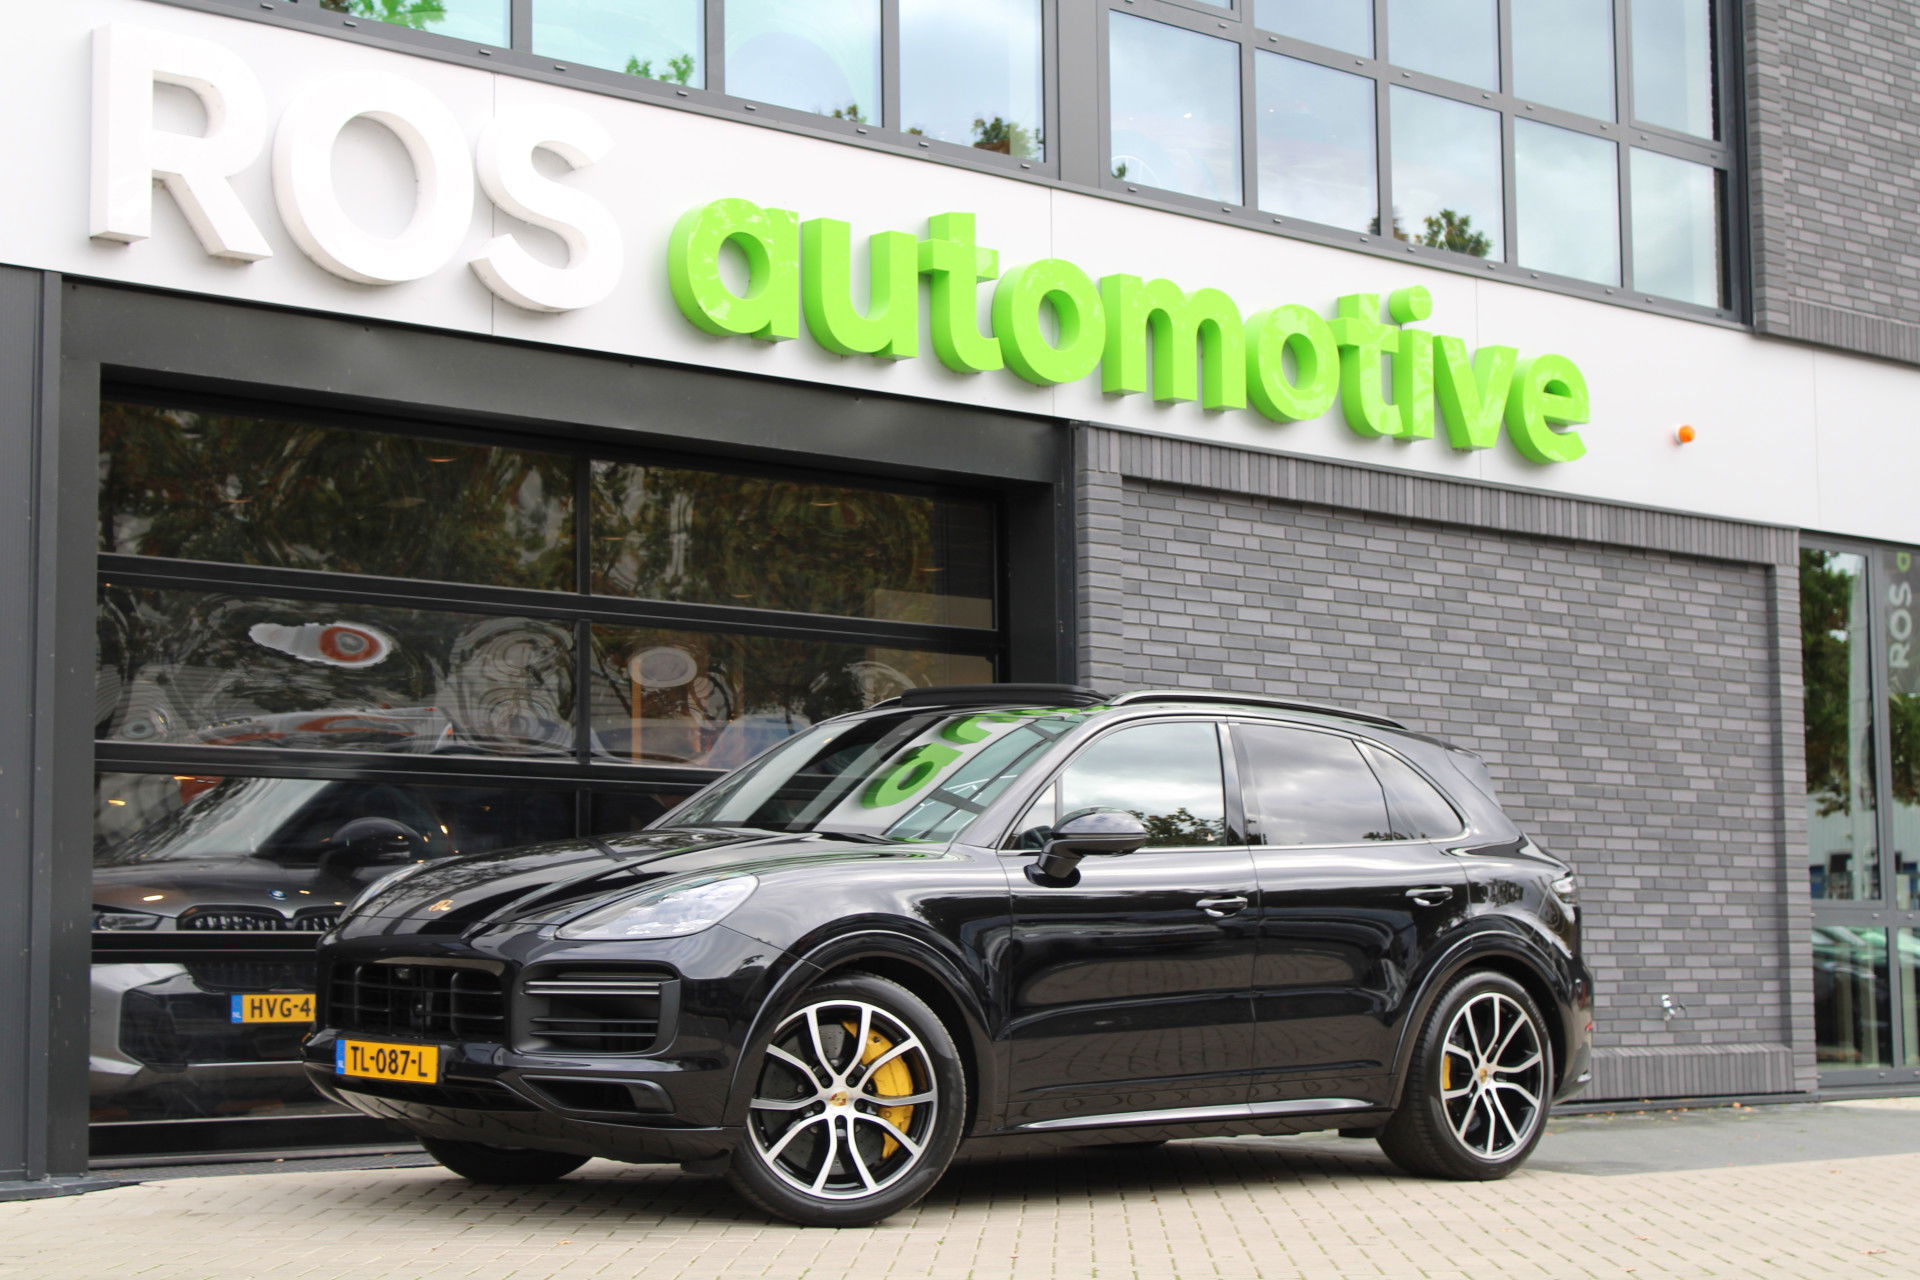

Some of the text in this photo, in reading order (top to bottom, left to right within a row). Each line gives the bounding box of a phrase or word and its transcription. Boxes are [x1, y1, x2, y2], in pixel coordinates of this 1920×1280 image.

[90, 22, 1590, 465] ROS automotive
[1890, 582, 1912, 669] ROS
[250, 997, 315, 1018] HVG-4
[351, 1046, 428, 1077] TL-087-L
